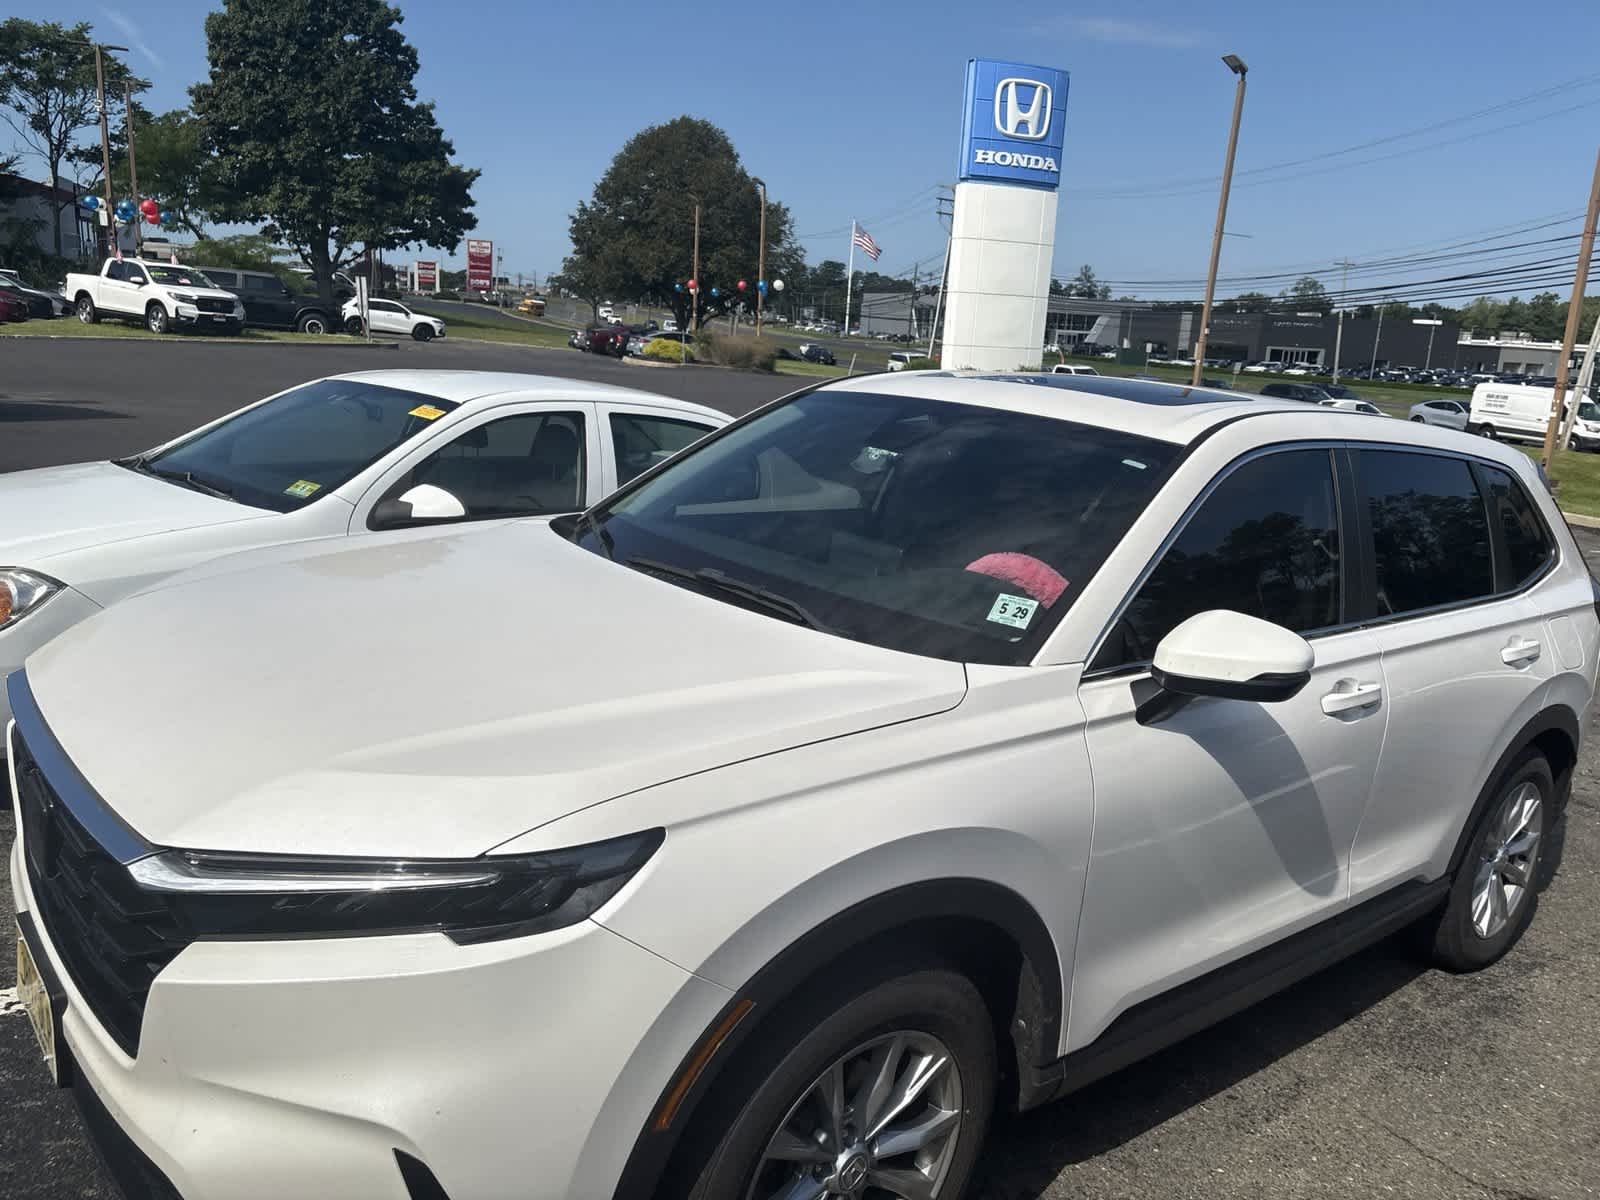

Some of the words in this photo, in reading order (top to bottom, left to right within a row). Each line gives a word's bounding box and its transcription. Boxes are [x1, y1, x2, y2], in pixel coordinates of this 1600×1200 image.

[974, 149, 1059, 172] HONDA
[999, 602, 1009, 615] 5
[1011, 606, 1029, 619] 29
